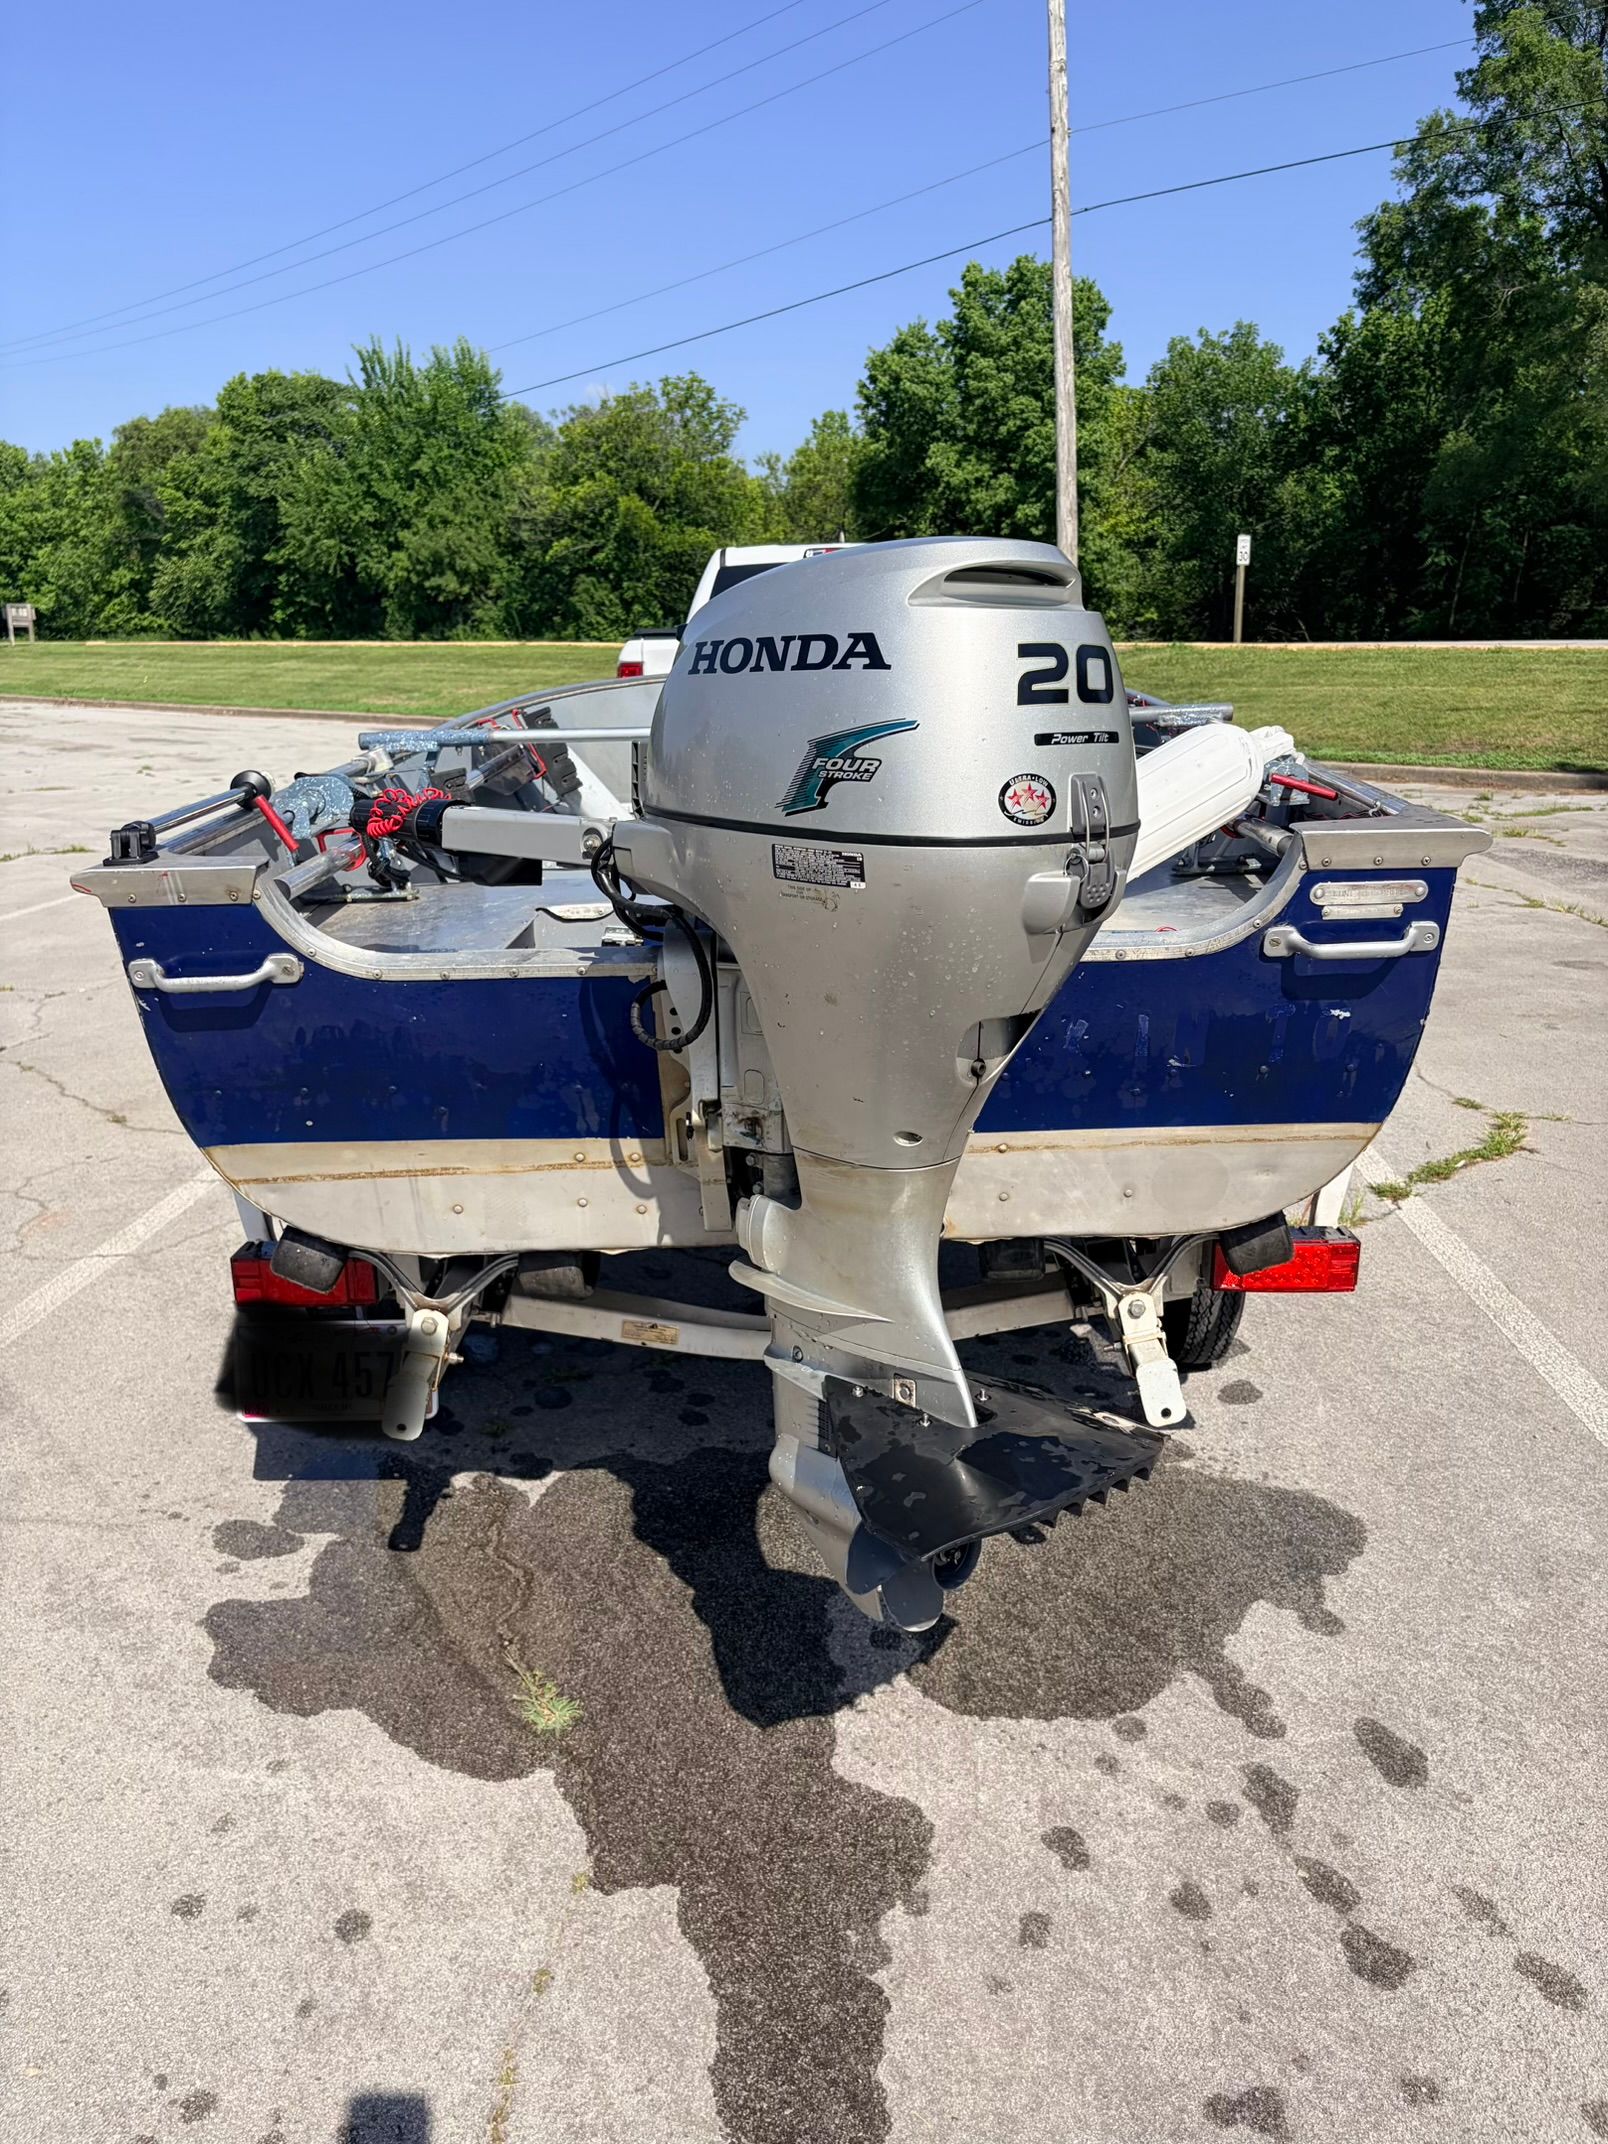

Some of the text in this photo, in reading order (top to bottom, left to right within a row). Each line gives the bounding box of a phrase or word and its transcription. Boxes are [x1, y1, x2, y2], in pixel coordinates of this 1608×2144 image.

[688, 632, 891, 675] HONDA
[1017, 643, 1114, 706] 20
[1051, 732, 1109, 744] Power Tilt
[812, 757, 881, 772] FOUR
[818, 770, 873, 781] STROKE
